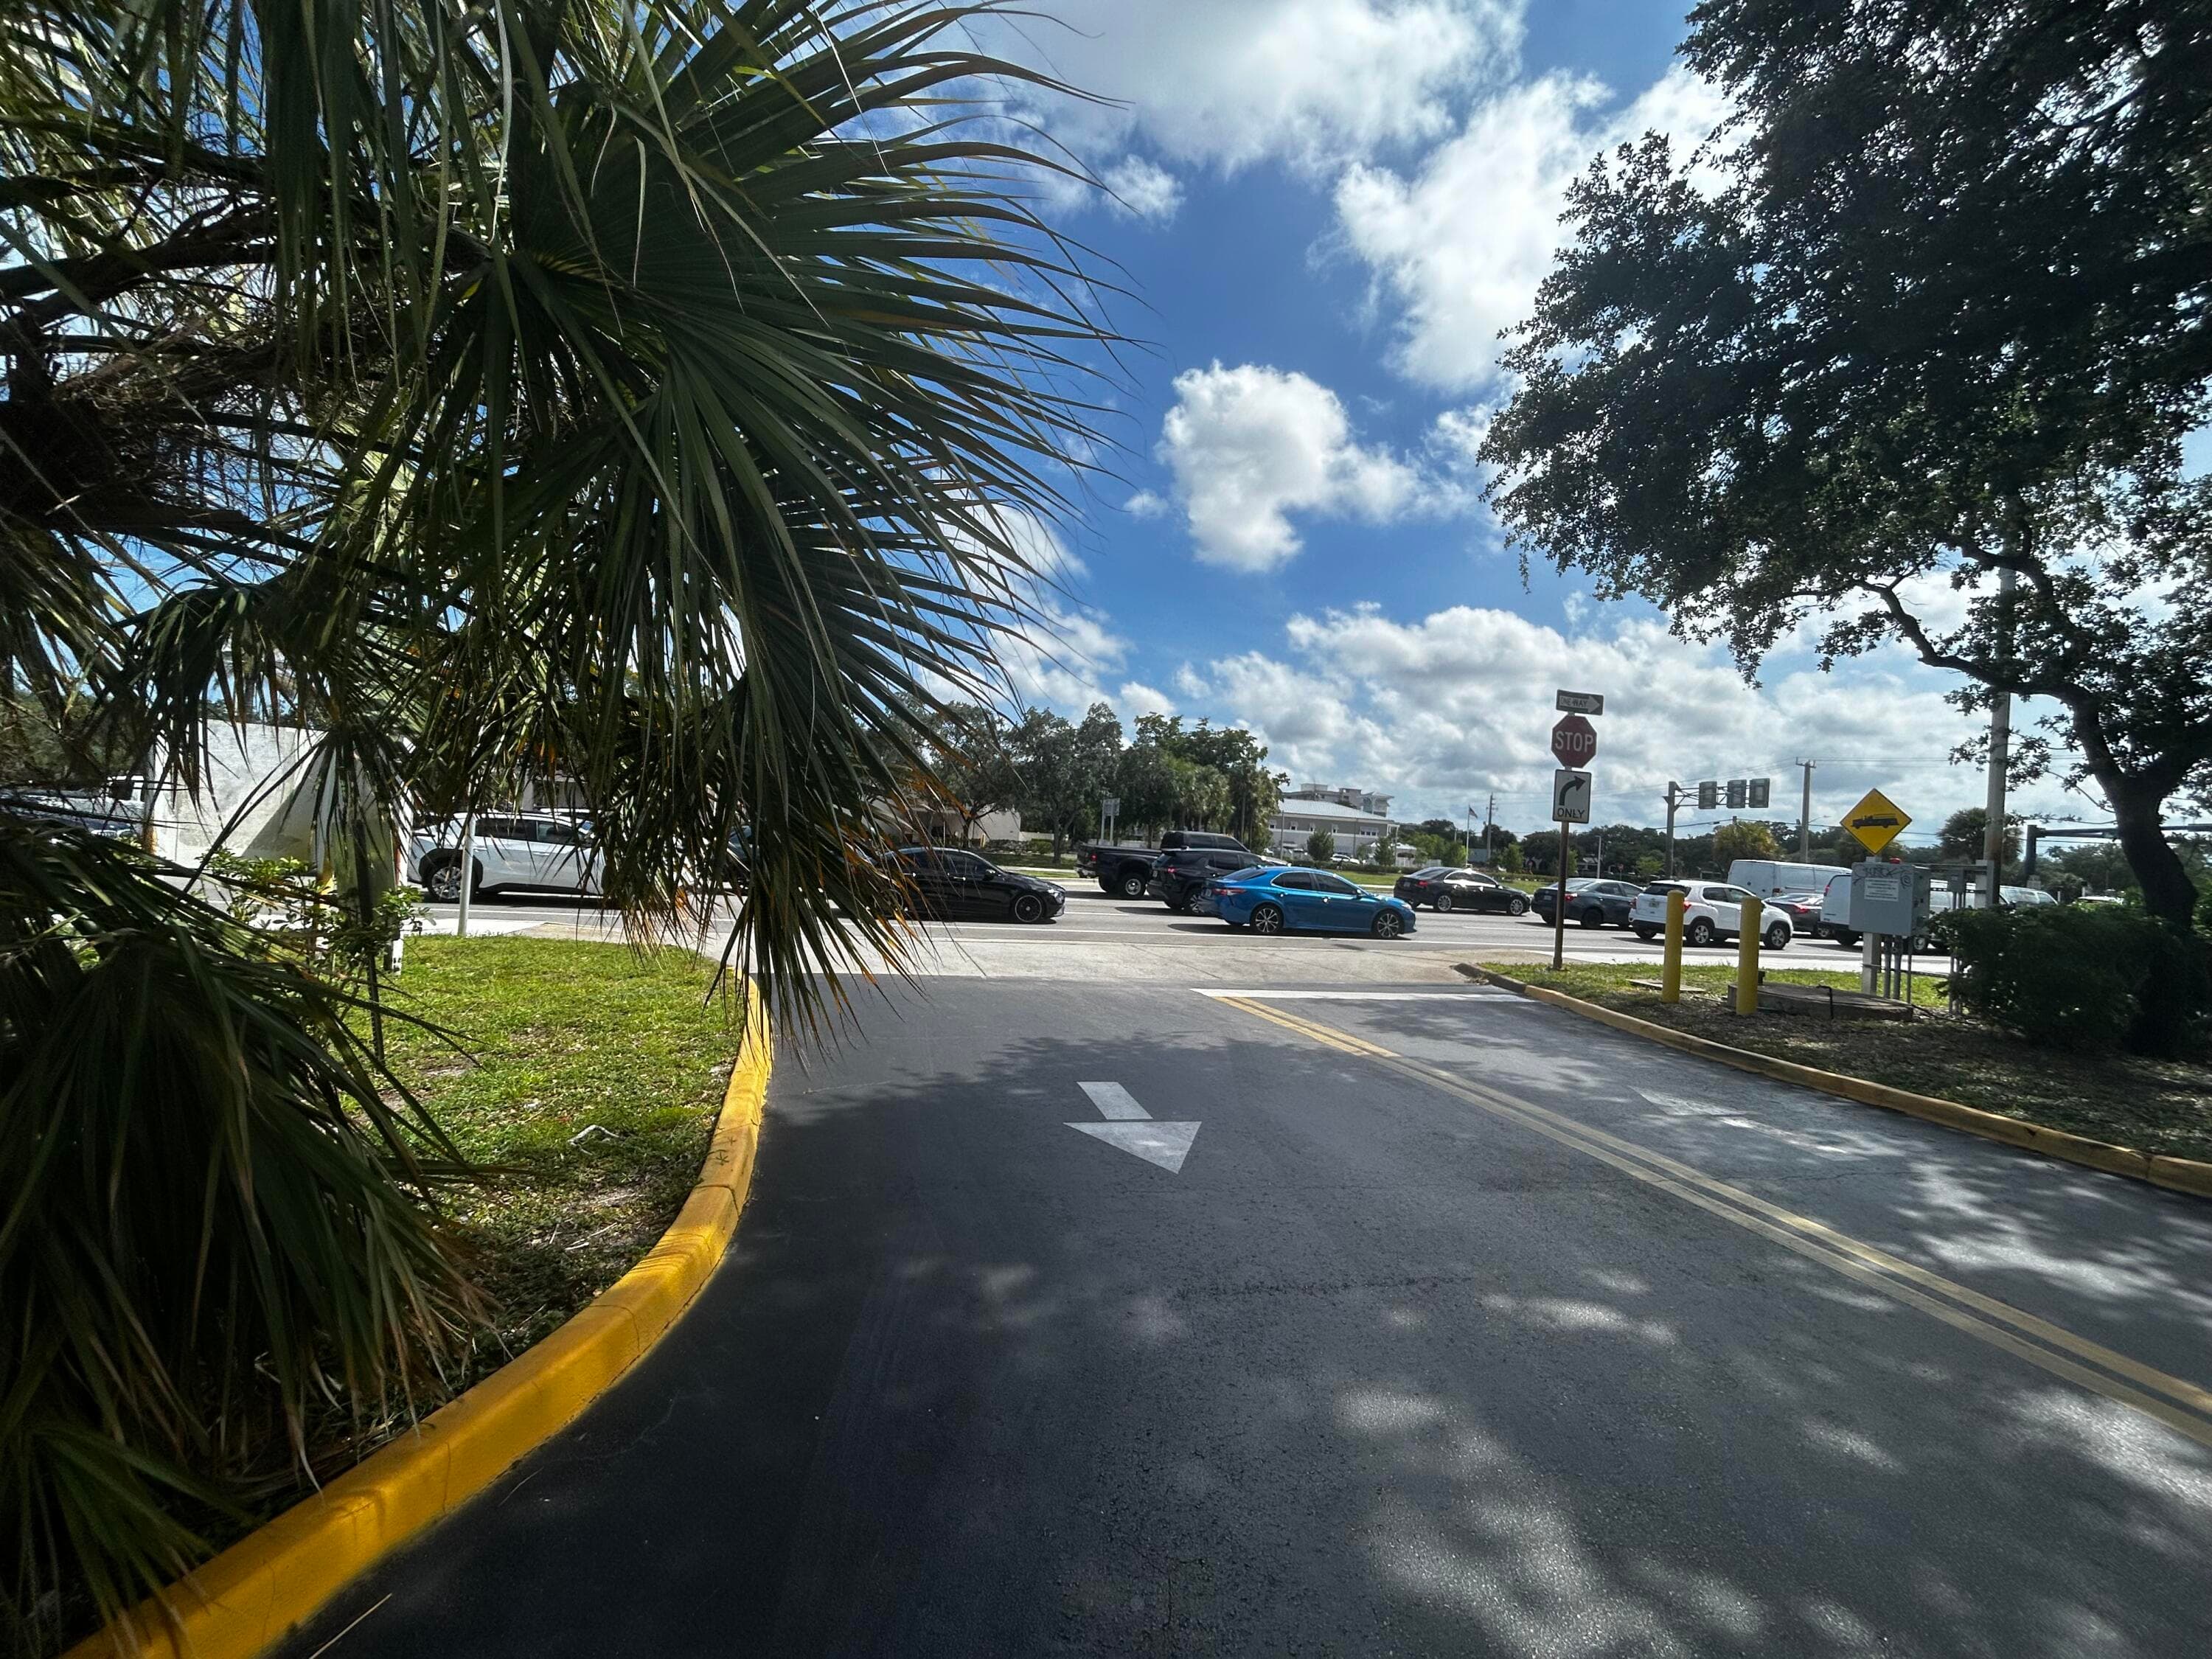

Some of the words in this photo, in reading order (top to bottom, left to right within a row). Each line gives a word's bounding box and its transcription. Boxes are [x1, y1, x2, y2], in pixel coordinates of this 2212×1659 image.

[1560, 696, 1571, 706] ONE
[1571, 698, 1587, 708] WAY
[1555, 730, 1594, 753] STOP
[1557, 807, 1585, 819] ONLY
